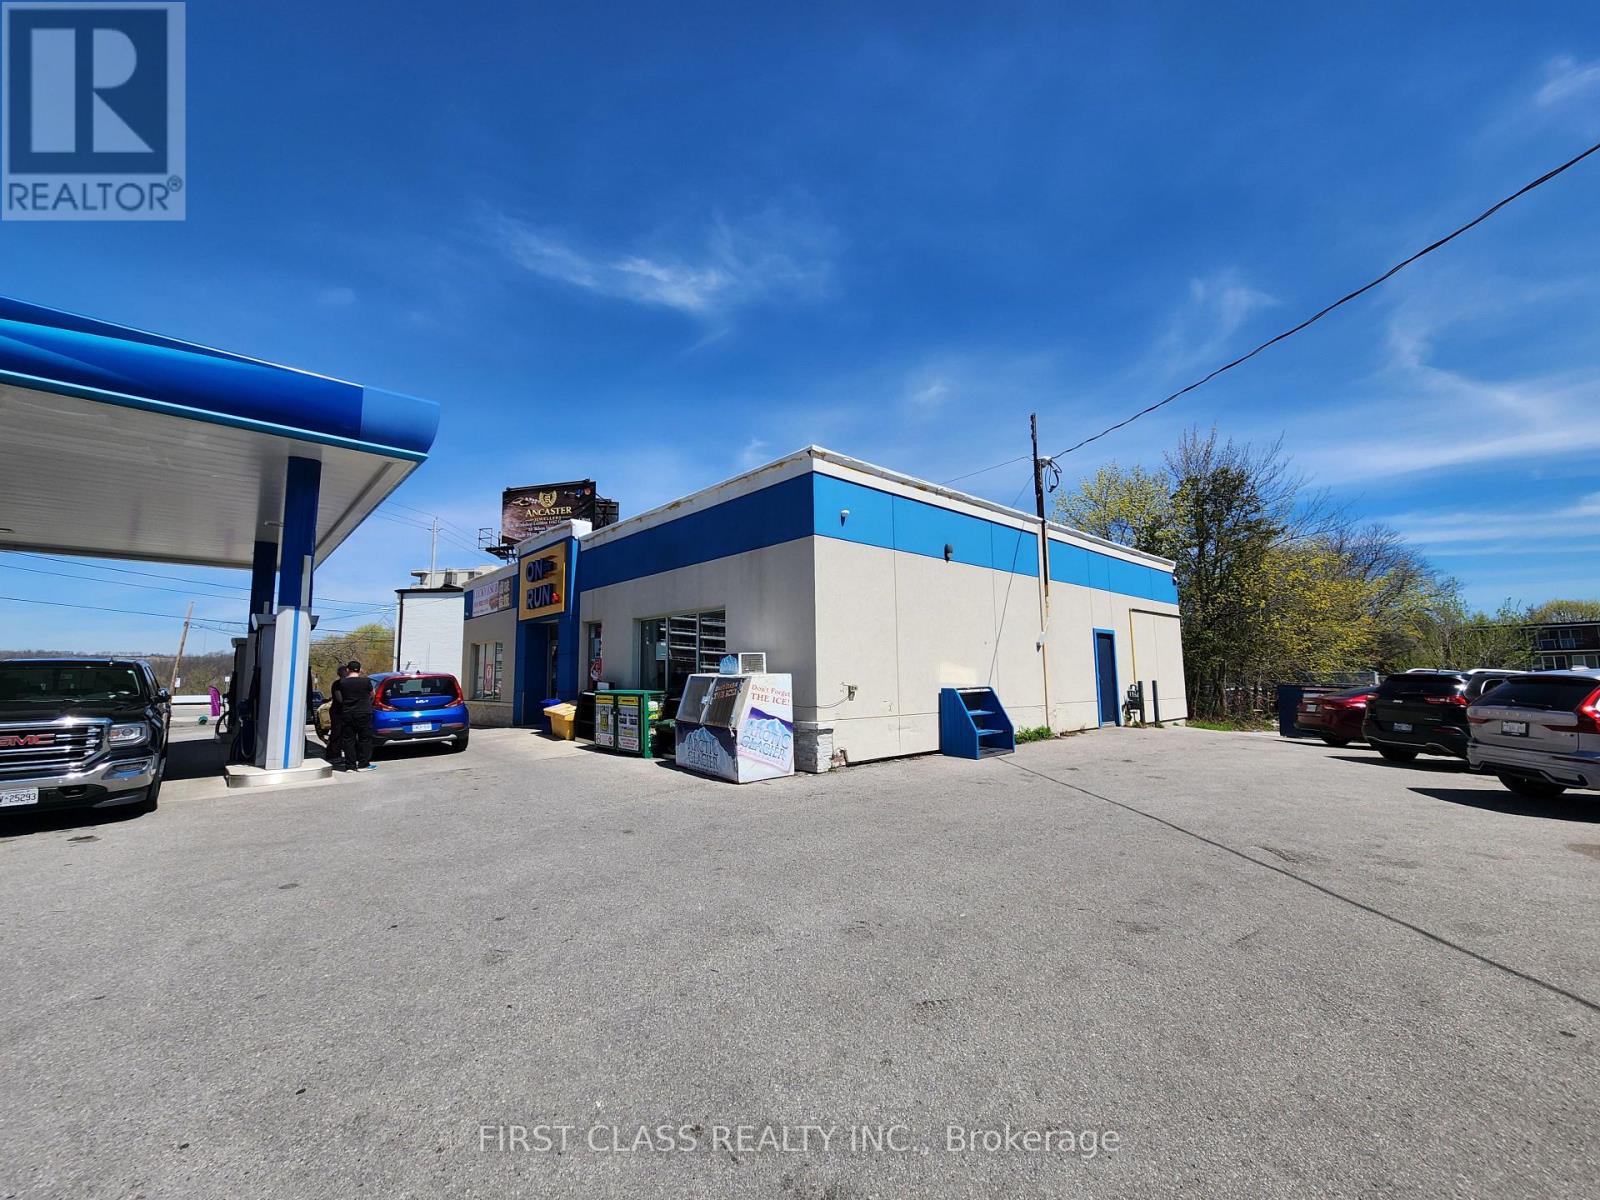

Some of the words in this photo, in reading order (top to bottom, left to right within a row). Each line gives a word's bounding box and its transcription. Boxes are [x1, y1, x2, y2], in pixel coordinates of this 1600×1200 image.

[525, 506, 572, 517] ANCASTER
[526, 560, 544, 582] ON
[527, 584, 552, 609] RUN
[751, 692, 770, 703] THE
[771, 695, 790, 706] ICE!
[687, 734, 719, 756] ARCTIC
[740, 735, 786, 760] GLACIER
